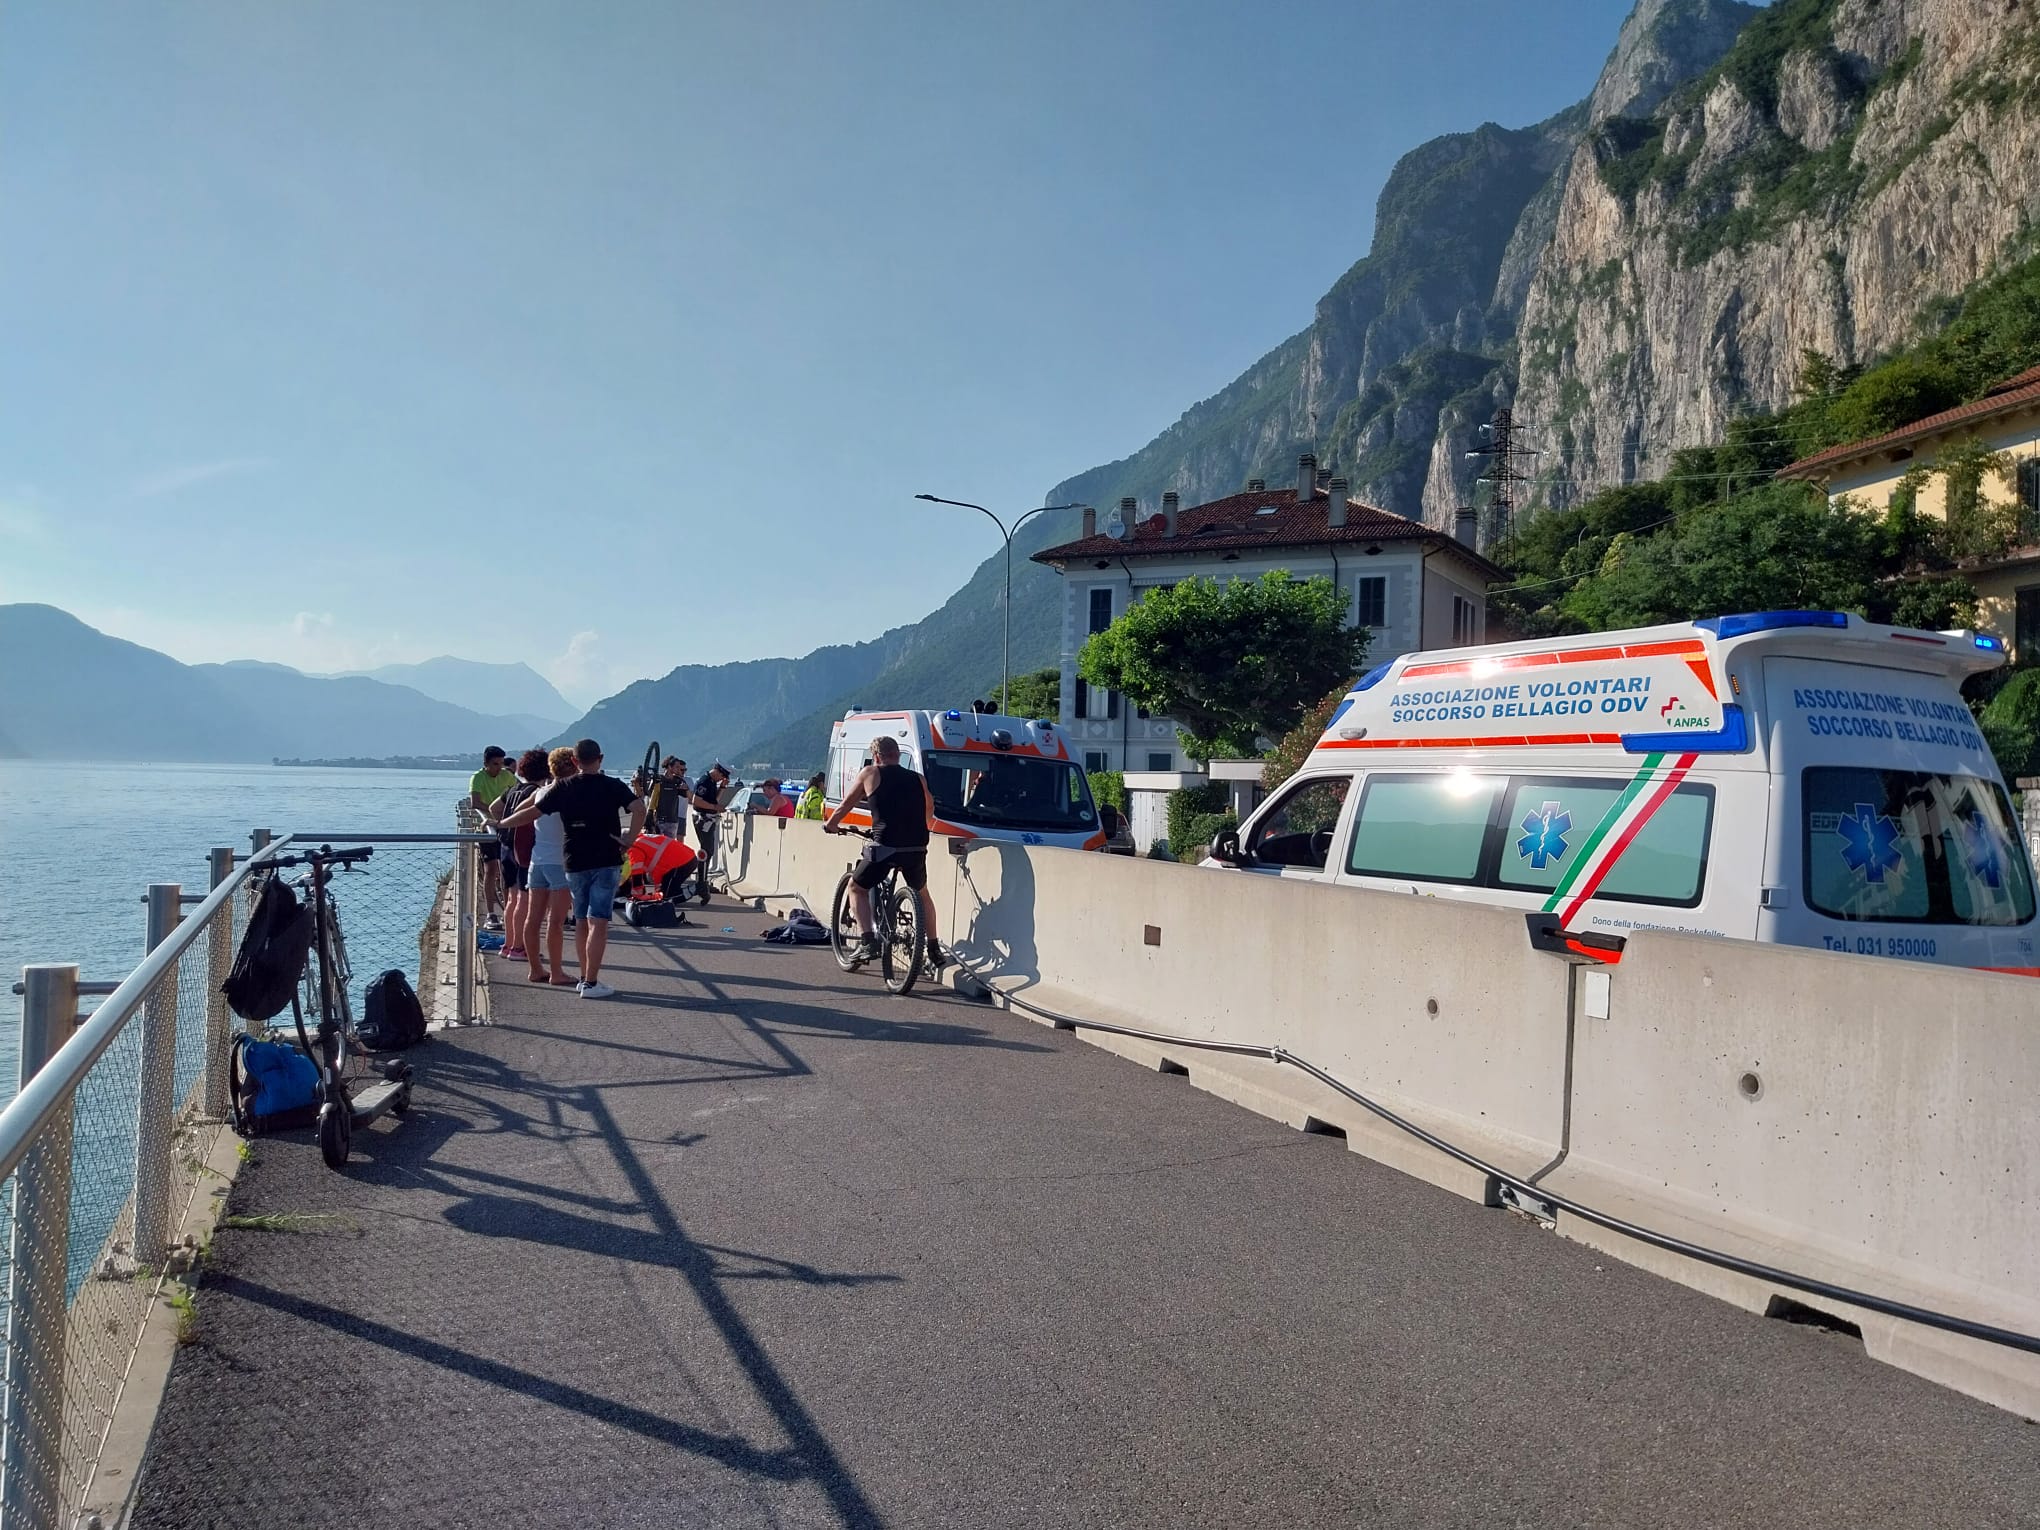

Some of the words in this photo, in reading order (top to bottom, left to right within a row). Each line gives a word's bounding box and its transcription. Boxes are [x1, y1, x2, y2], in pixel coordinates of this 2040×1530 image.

[1390, 685, 1520, 707] ASSOCIAZIONE
[1528, 676, 1651, 698] VOLONTARI
[1793, 689, 1905, 716] ASSOCIAZIONE
[1393, 705, 1486, 723] SOCCORSO
[1492, 699, 1593, 718] BELLAGIO
[1601, 696, 1648, 713] ODV
[1674, 717, 1710, 728] ANPAS
[1807, 715, 1893, 740] SOCCORSO
[1895, 721, 1959, 748] BELLAGIO
[1960, 731, 1983, 752] ODV
[1592, 916, 1612, 926] Dono
[1613, 919, 1632, 929] della
[1823, 936, 1851, 953] Tel.
[1857, 937, 1882, 955] 031
[1888, 939, 1936, 957] 950000
